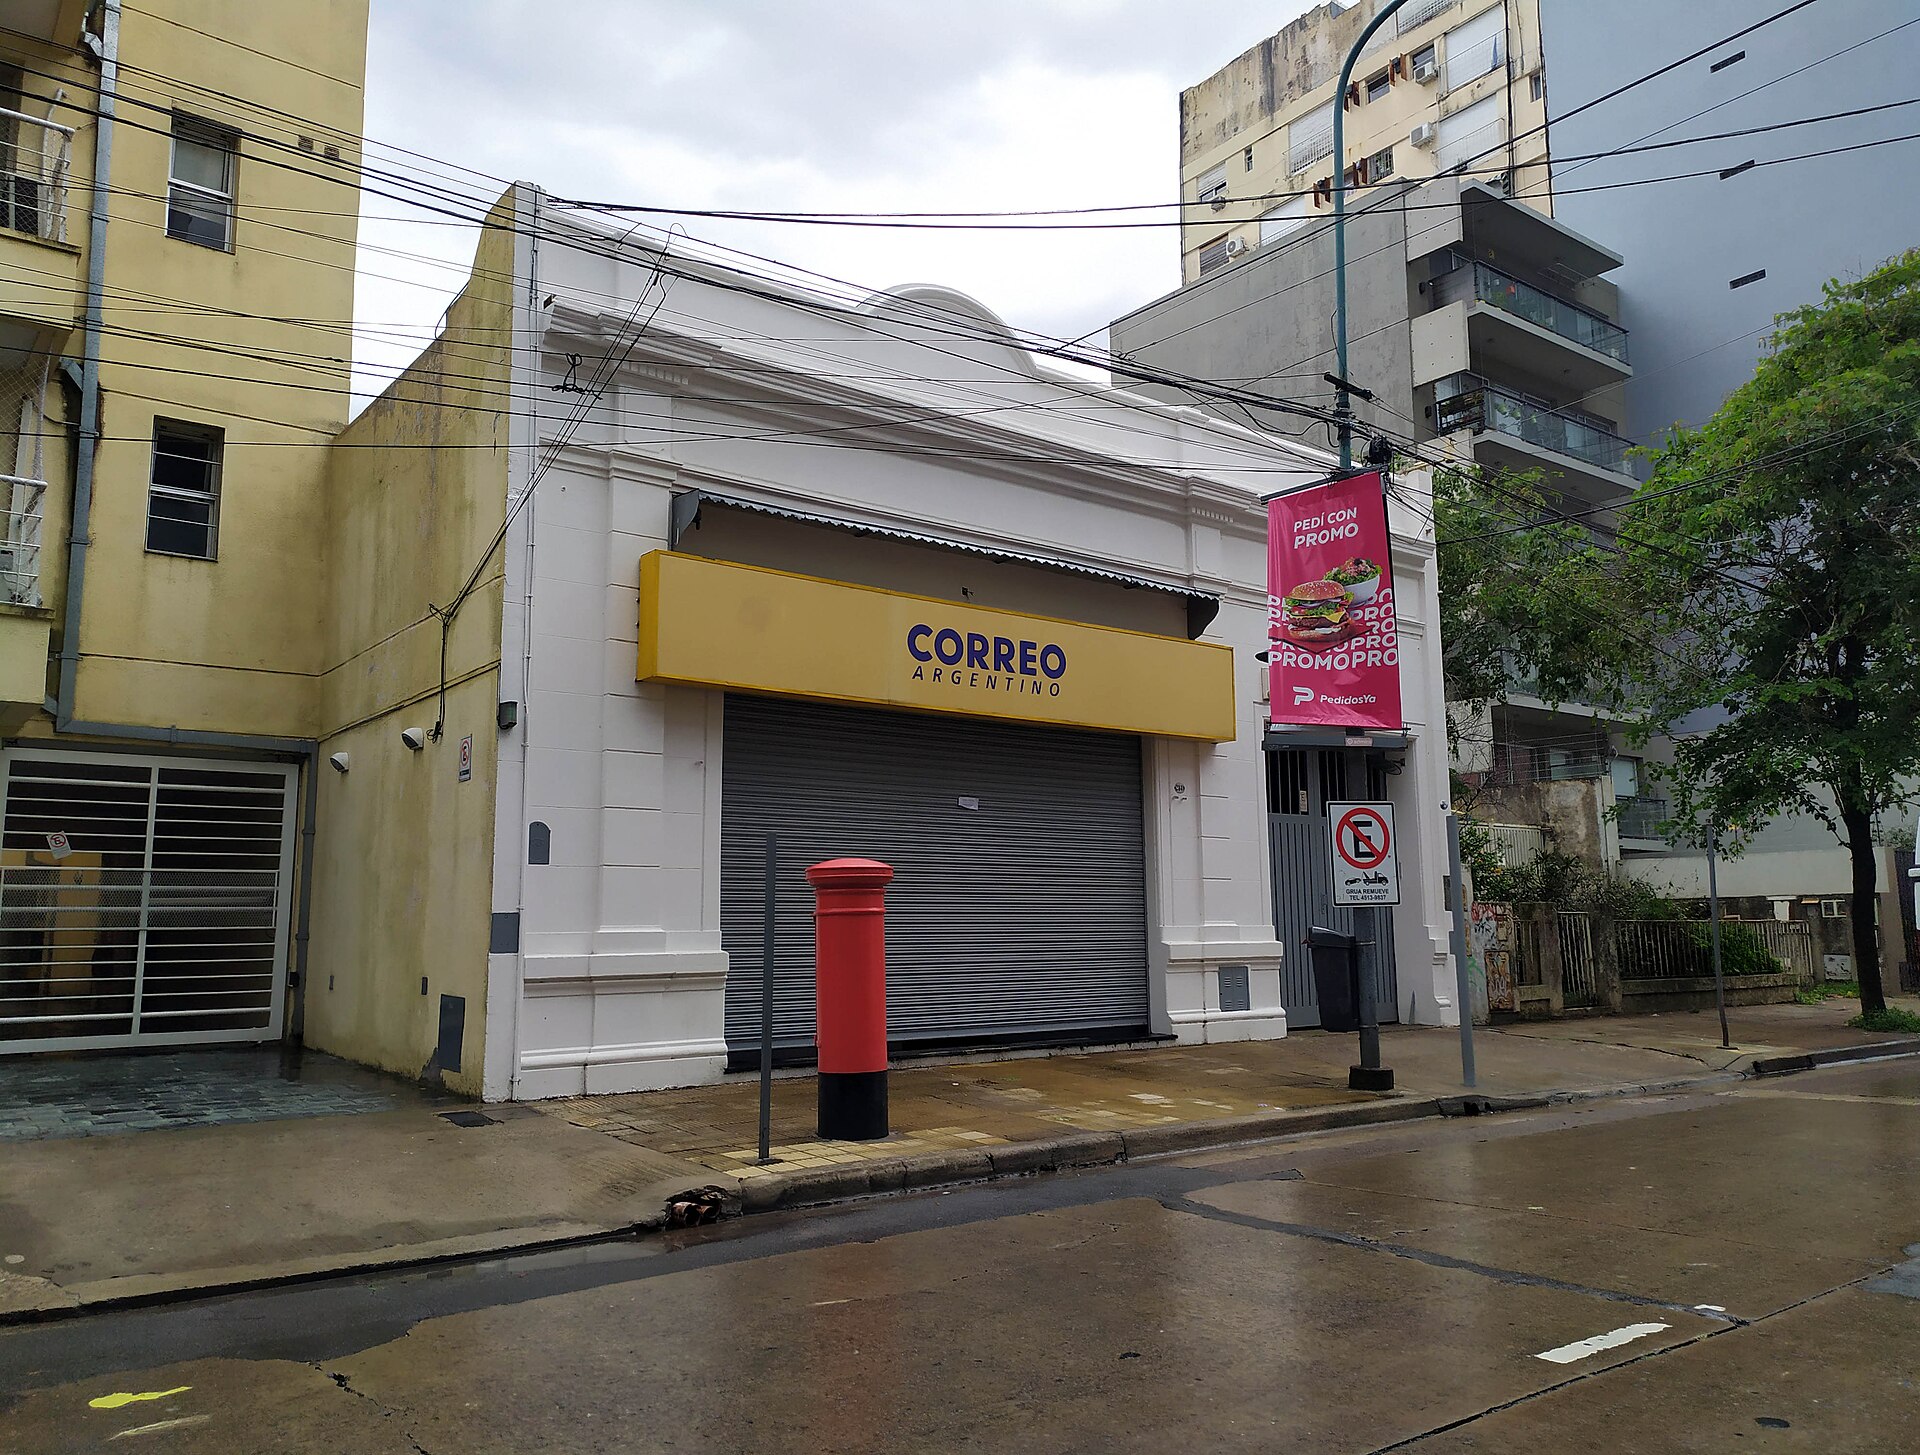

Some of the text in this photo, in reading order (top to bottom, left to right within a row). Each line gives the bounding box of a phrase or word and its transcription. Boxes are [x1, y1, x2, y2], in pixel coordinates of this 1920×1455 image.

[1294, 507, 1357, 533] PEDÍ CON
[1294, 523, 1359, 549] PROMO
[907, 624, 1067, 679] CORREO
[912, 665, 1060, 697] ARGENTINO
[1320, 694, 1377, 705] PedidosYa
[1353, 821, 1375, 858] E
